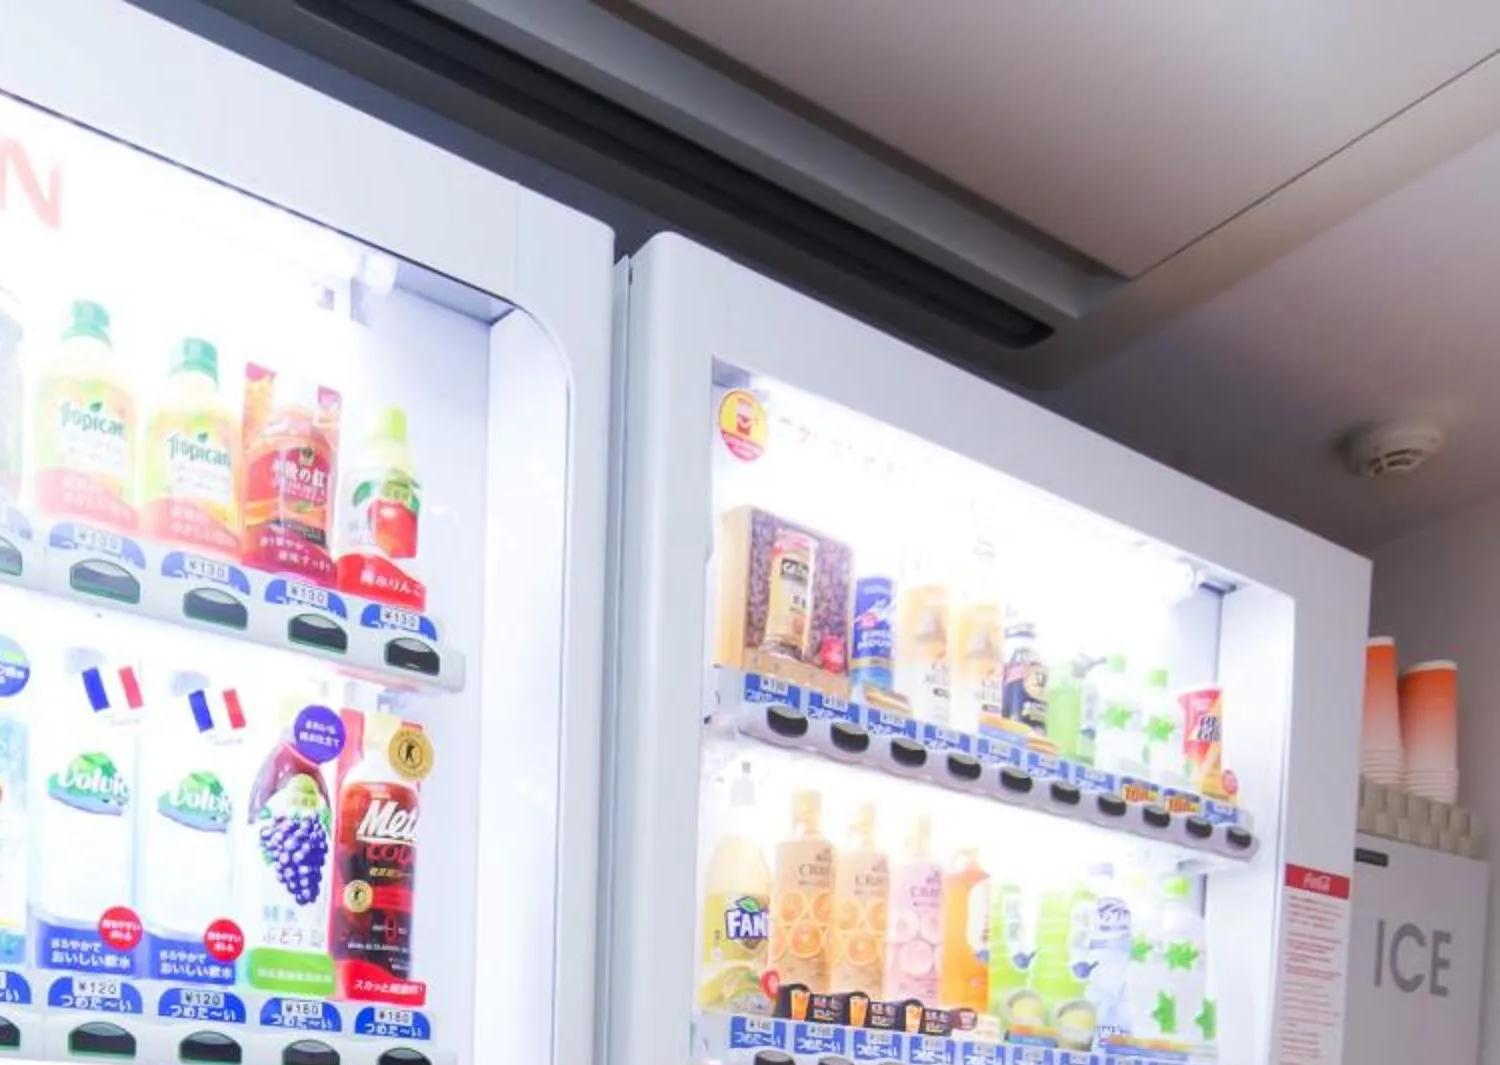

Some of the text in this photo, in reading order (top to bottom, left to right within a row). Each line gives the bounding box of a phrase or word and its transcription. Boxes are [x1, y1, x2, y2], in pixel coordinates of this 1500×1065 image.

[187, 557, 227, 579] ¥130
[1372, 918, 1453, 998] ICE
[78, 982, 118, 996] ¥120
[183, 992, 222, 1007] ¥120
